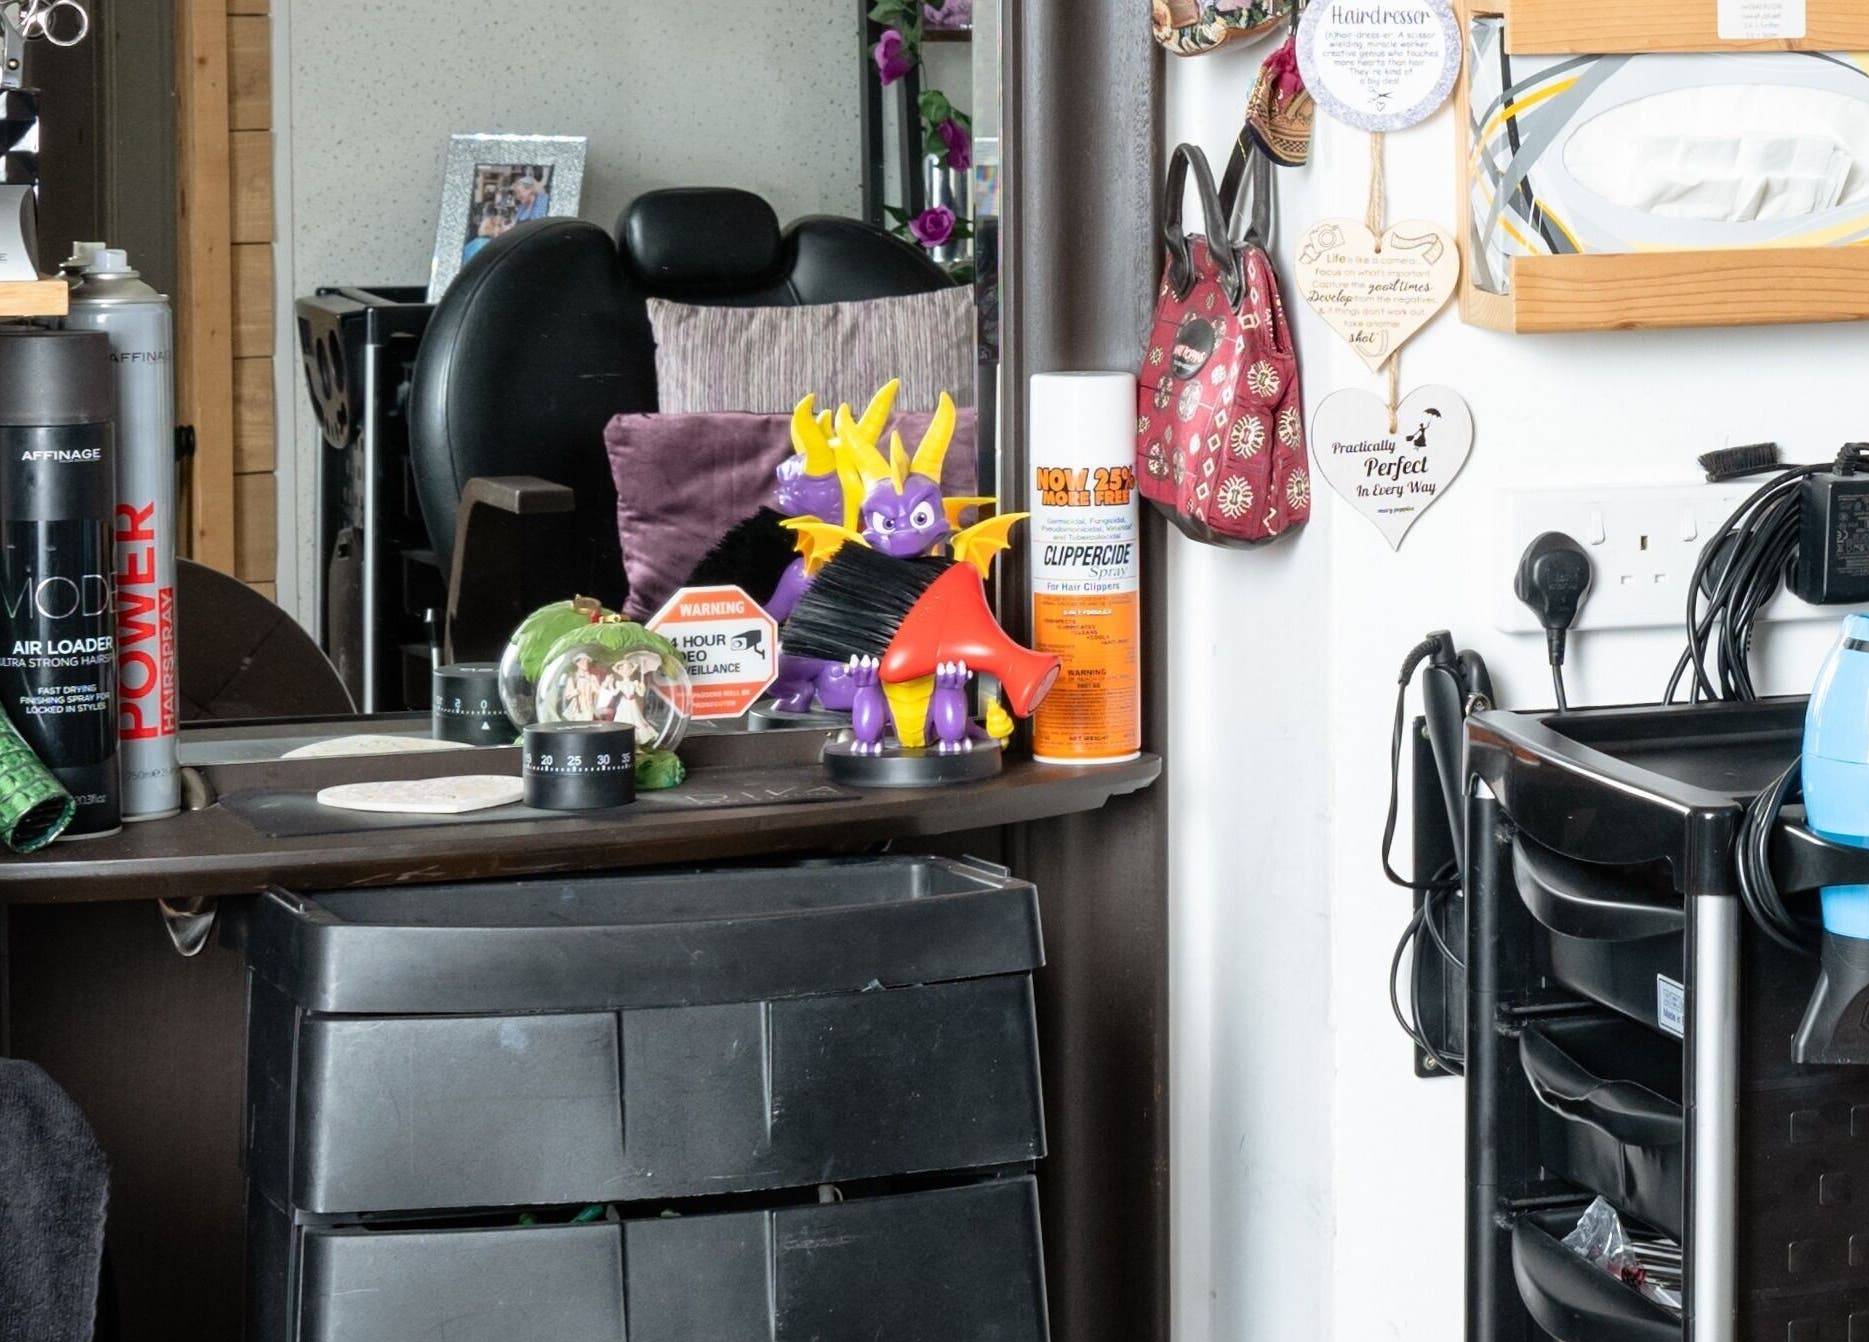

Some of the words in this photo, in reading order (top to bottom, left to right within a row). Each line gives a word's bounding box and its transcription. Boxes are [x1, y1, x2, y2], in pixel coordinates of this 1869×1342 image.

[1332, 5, 1430, 25] Hairdresser
[1326, 254, 1346, 263] Life
[1306, 289, 1353, 306] Develop
[1349, 330, 1375, 343] shot
[1332, 439, 1396, 454] Practically
[22, 448, 102, 461] AFFINAGE
[1364, 456, 1429, 481] Perfect
[1036, 466, 1090, 492] NOW
[1094, 465, 1136, 491] 25%
[1356, 484, 1370, 497] In
[1372, 483, 1404, 498] Every
[1407, 480, 1437, 495] Way
[1042, 490, 1091, 507] MORE
[1094, 489, 1130, 506] FREE
[1044, 543, 1132, 567] CLIPPERCIDE
[1088, 566, 1129, 580] Spray
[1047, 582, 1059, 591] For
[1061, 582, 1081, 591] Hair
[1083, 581, 1120, 592] Clippers
[680, 600, 746, 617] WARNING
[116, 501, 159, 741] POWER
[12, 640, 42, 655] AIR
[47, 635, 113, 655] LOADER
[683, 633, 726, 648] HOUR
[28, 656, 79, 668] STRONG
[161, 592, 175, 734] HAIRSPRAY
[37, 686, 61, 695] FAST
[63, 684, 97, 695] DRYING
[67, 693, 94, 703] SPRAY
[26, 704, 65, 714] LOCKED
[66, 704, 76, 713] IN
[540, 754, 554, 766] 20
[567, 755, 583, 767] 25
[596, 753, 611, 765] 30
